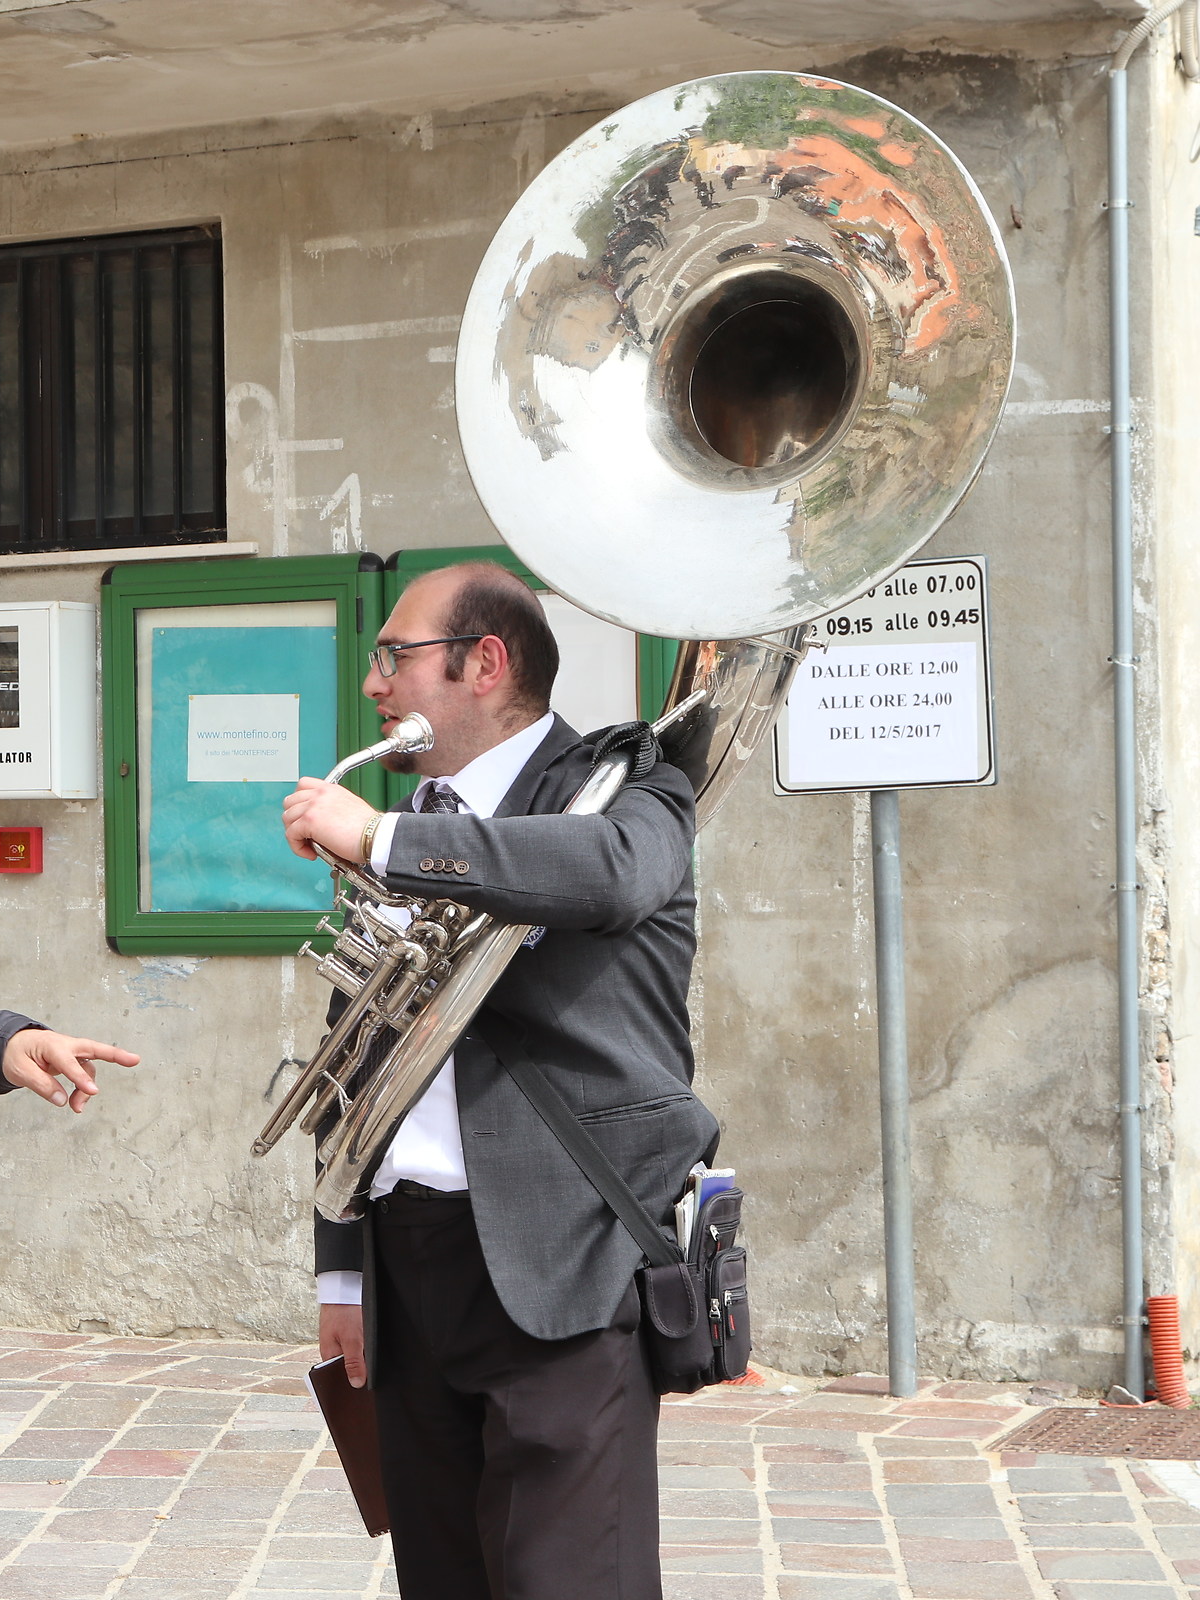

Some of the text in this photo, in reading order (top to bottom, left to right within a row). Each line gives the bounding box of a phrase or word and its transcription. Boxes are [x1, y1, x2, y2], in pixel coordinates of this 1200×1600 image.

[884, 578, 918, 597] alle
[885, 613, 919, 631] alle
[811, 660, 959, 679] DALLE ORE 12,00
[817, 692, 953, 710] ALLE ORE 24,00
[196, 729, 287, 741] www.montefino.org
[829, 724, 942, 741] DEL 12/5/2017
